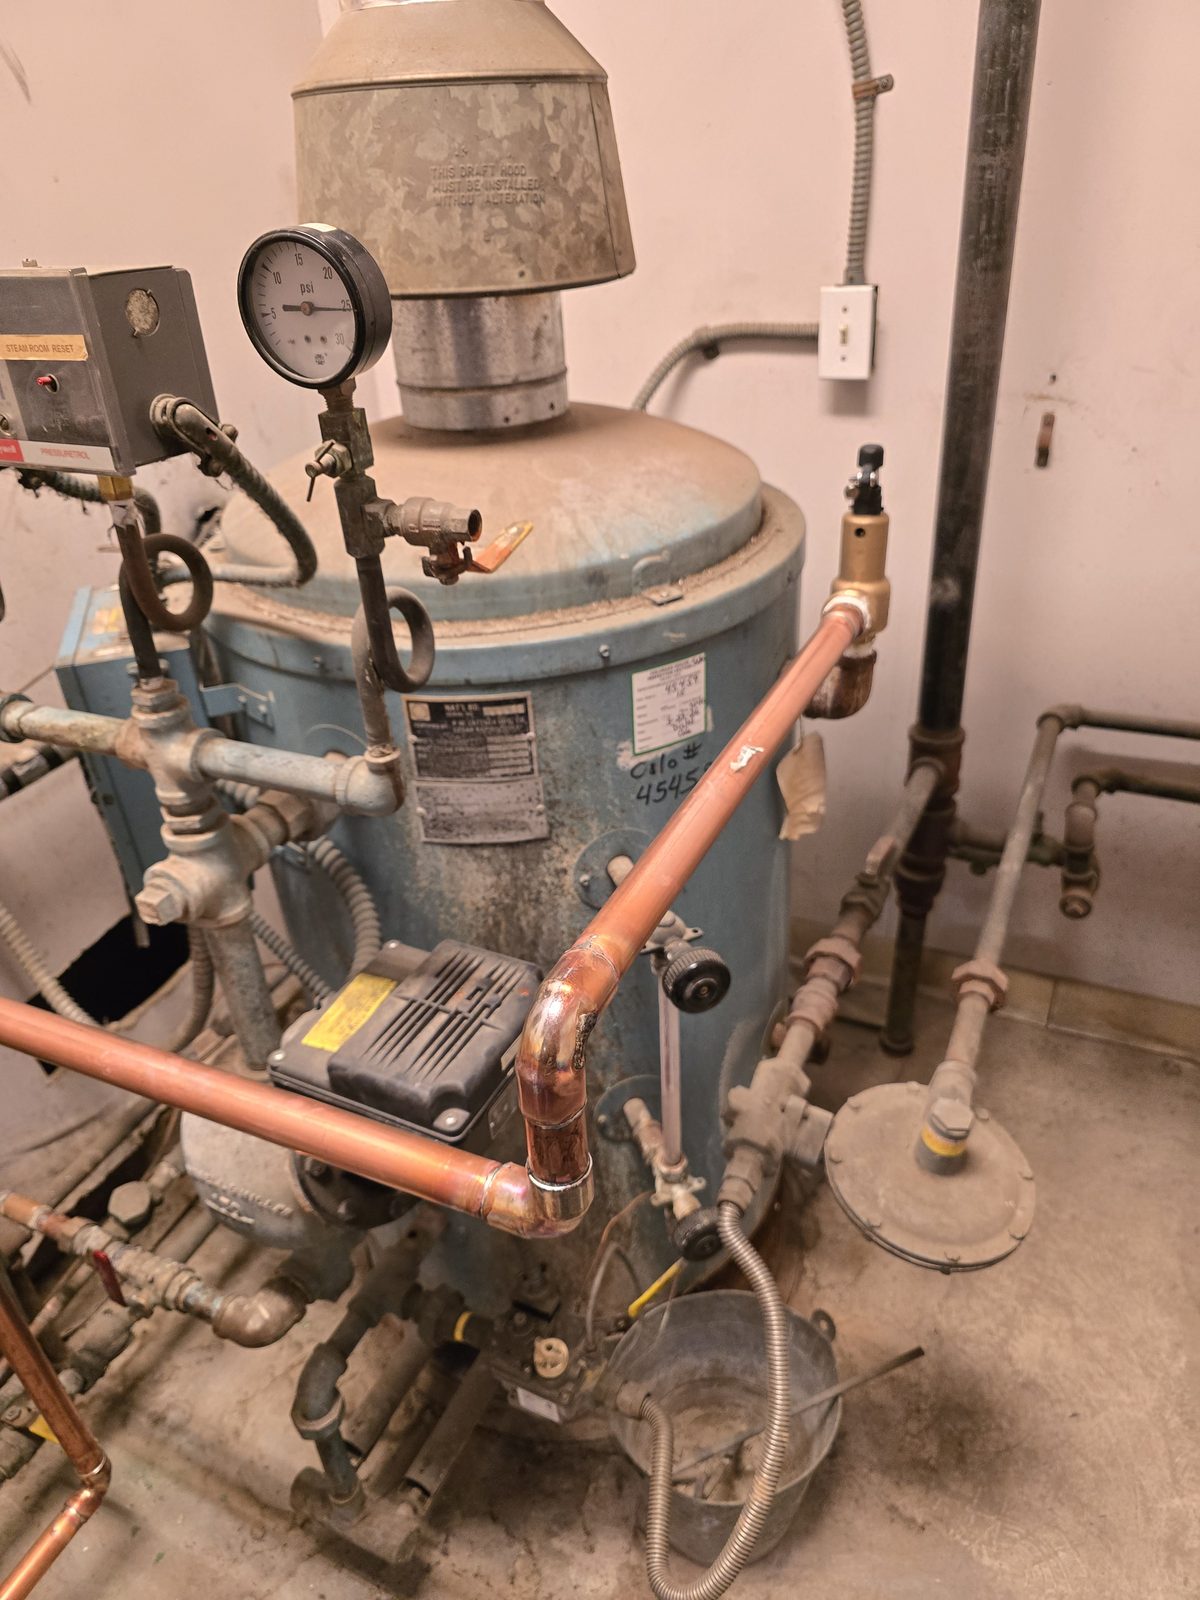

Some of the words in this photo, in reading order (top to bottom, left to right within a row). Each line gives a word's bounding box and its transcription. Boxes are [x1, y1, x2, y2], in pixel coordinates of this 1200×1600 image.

[429, 164, 456, 180] THIS
[459, 163, 496, 178] DRAFT
[500, 162, 527, 177] HOOD
[431, 179, 461, 193] MUST
[466, 179, 481, 192] BE
[294, 253, 304, 267] 15
[272, 271, 282, 285] 10
[322, 266, 333, 280] 20
[300, 281, 315, 296] psi
[270, 307, 277, 320] 5
[340, 300, 352, 313] 25
[334, 332, 345, 346] 30
[5, 344, 28, 353] STEAM
[29, 344, 50, 353] ROOM
[52, 344, 75, 353] RESET
